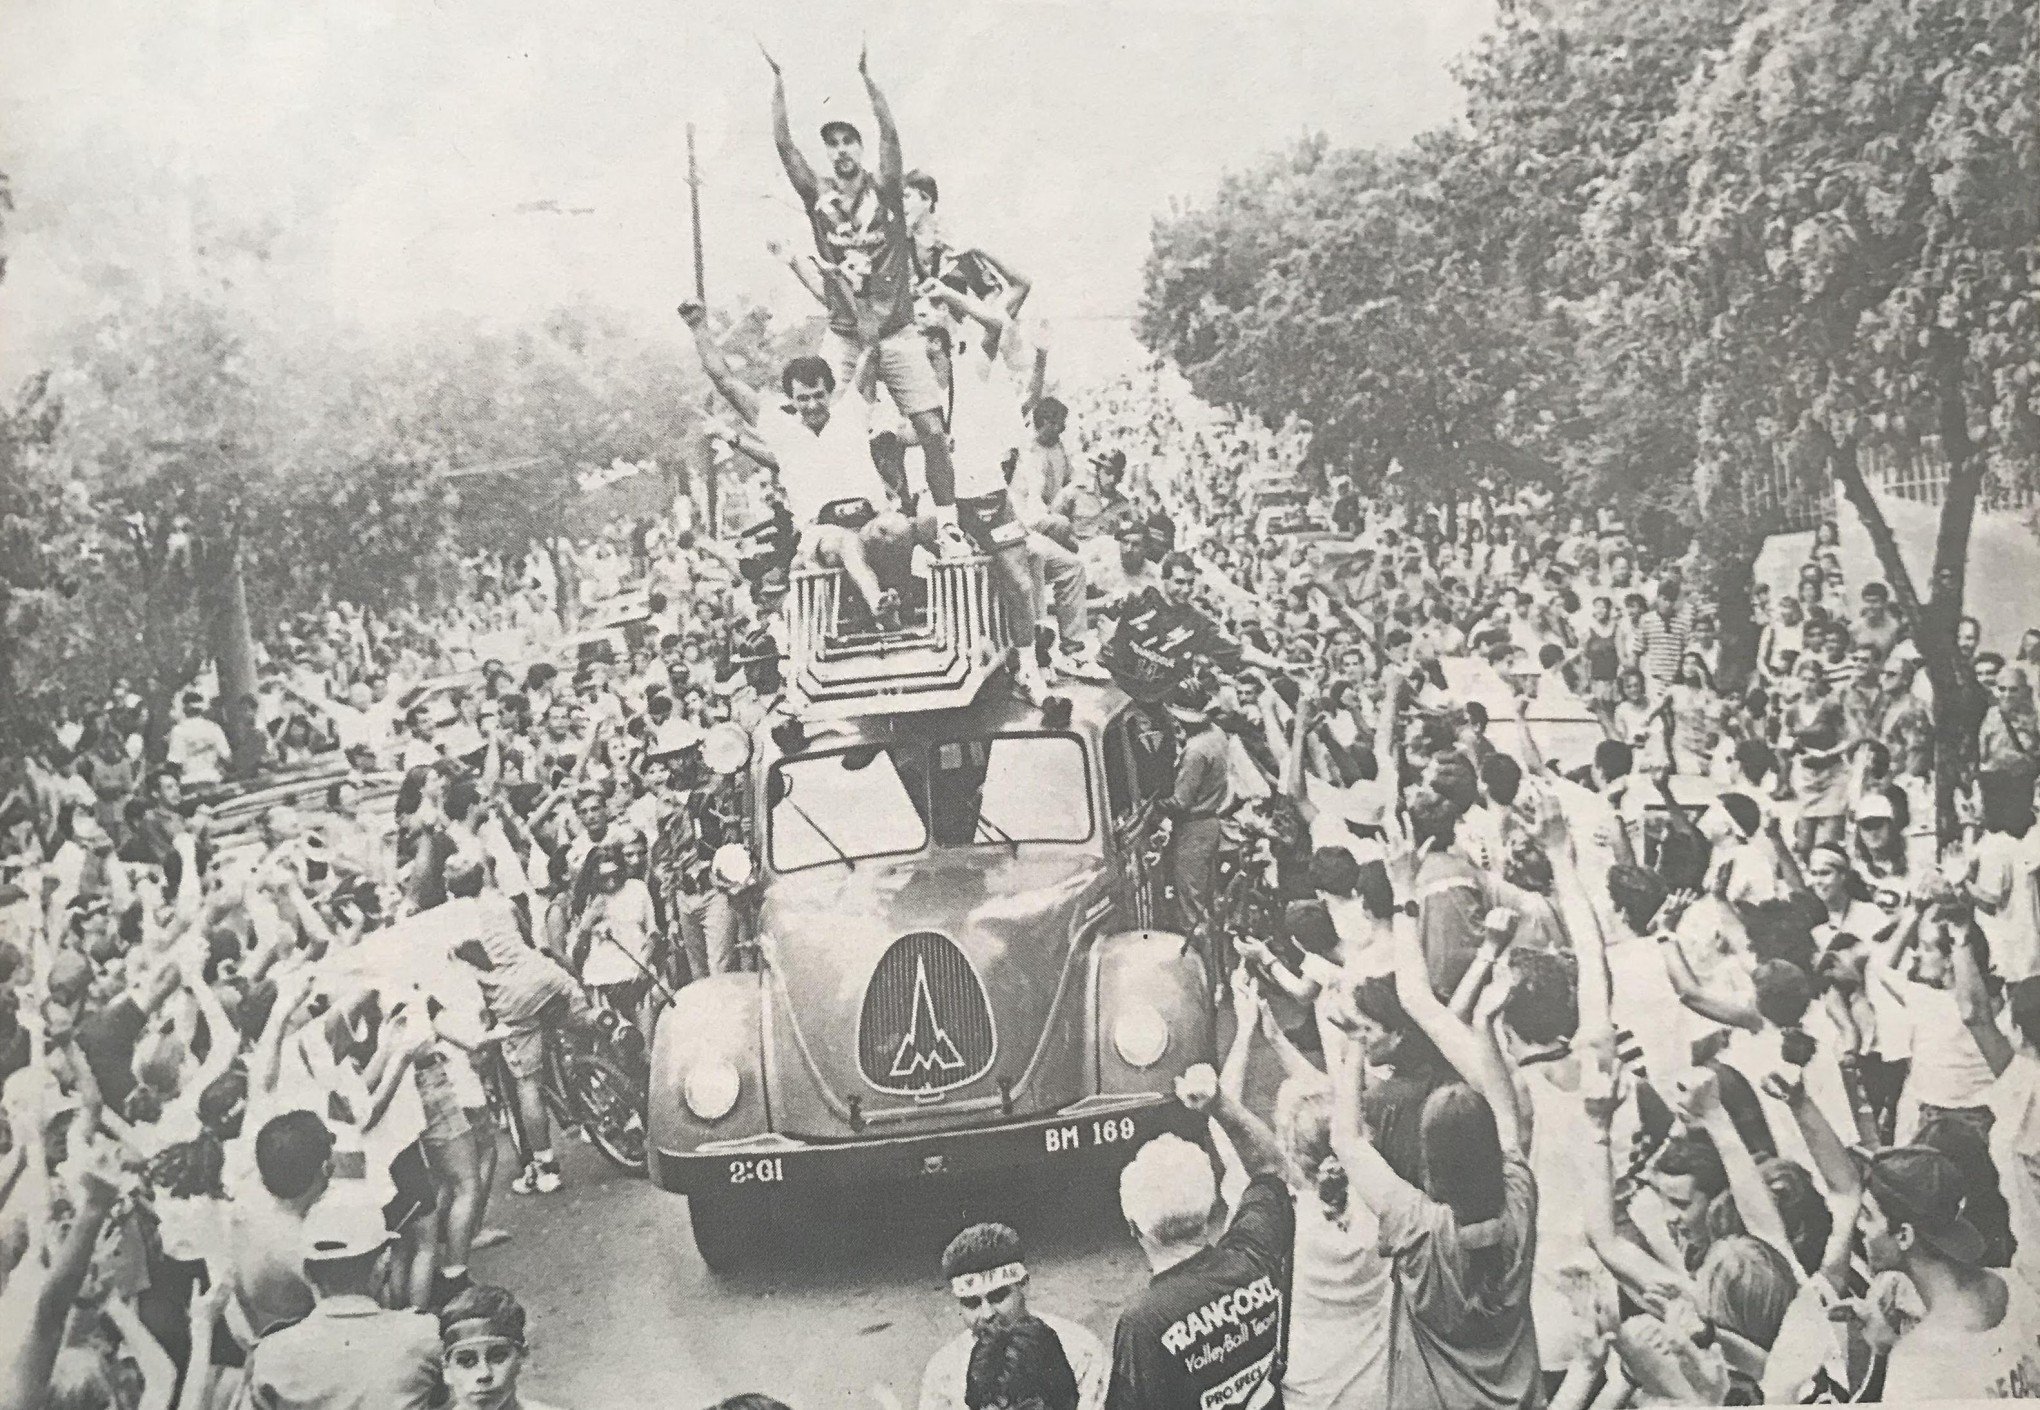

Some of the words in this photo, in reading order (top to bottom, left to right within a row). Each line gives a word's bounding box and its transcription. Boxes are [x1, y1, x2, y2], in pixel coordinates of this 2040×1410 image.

[1045, 1125, 1079, 1152] BM
[1093, 1117, 1135, 1145] 169
[1204, 1386, 1233, 1408] PRO
